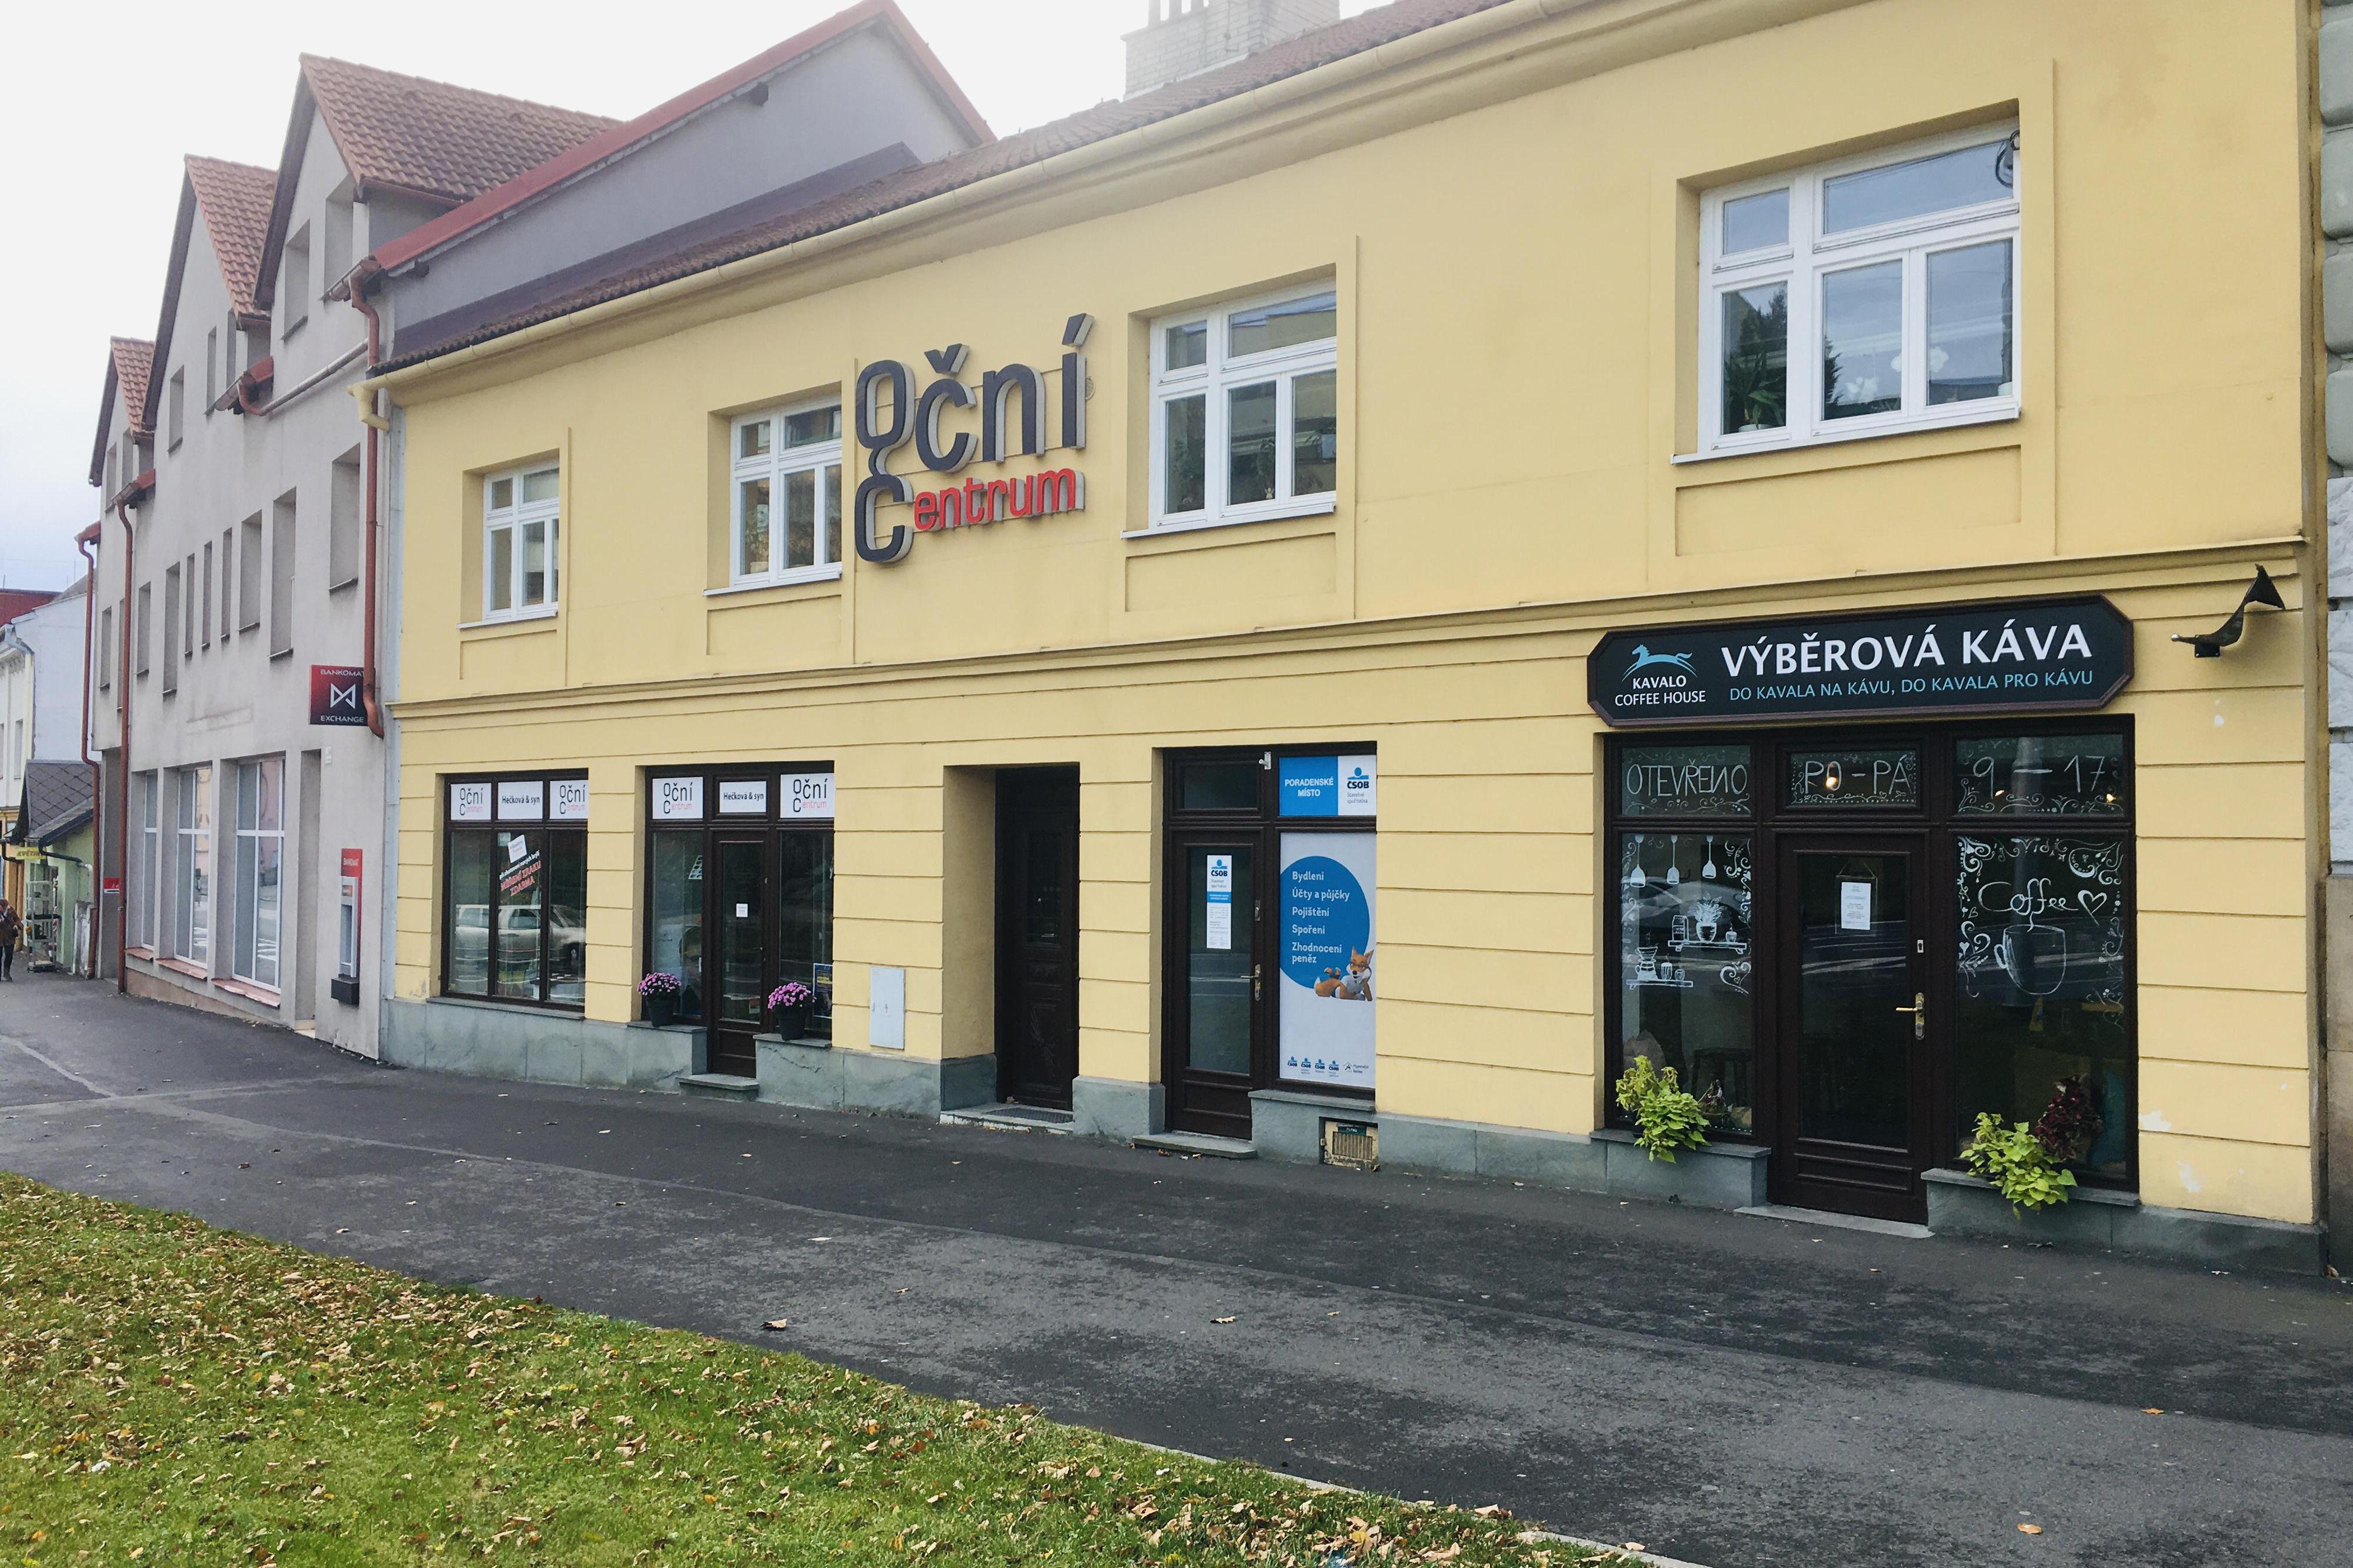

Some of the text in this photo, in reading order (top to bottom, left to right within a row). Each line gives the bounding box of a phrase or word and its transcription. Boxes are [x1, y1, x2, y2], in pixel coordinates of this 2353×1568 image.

[856, 313, 1094, 472] Oční
[855, 468, 1085, 562] Centrum
[1721, 619, 2092, 677] VÝBĚROVÁ KÁVA
[1632, 675, 1687, 690] KAVALO
[1729, 668, 2092, 700] DO KAVALA NA KÁVU, DO KAVALA PRO KÁVU
[1615, 690, 1706, 706] COFFEE HOUSE
[320, 715, 365, 723] EXCHANGE
[1285, 776, 1334, 786] PORADENSKÉ
[1627, 758, 1748, 797] OTEVŘENO
[1805, 760, 1842, 794] PO
[1874, 754, 1913, 795] PÁ
[1973, 756, 1994, 799] 9
[2064, 755, 2105, 793] 17
[663, 782, 693, 802] Oční
[793, 778, 828, 800] Oční
[1298, 787, 1321, 797] MÍSTO
[1347, 780, 1369, 789] ČSOB
[459, 787, 484, 805] Oční
[502, 795, 540, 805] Hečková & syn
[559, 785, 586, 803] Oční
[724, 792, 764, 802] Hečková & syn
[663, 800, 692, 814] Centrum
[792, 798, 827, 813] Centrum
[1292, 871, 1324, 883] Bydlení
[1292, 886, 1312, 900] Účty
[1321, 889, 1350, 902] půjčky
[1978, 878, 2079, 916] Coffee
[1292, 906, 1330, 919] Pojištění
[1292, 924, 1325, 936] Spoření
[1292, 942, 1342, 953] Zhodnocení
[1292, 954, 1317, 965] peněz
